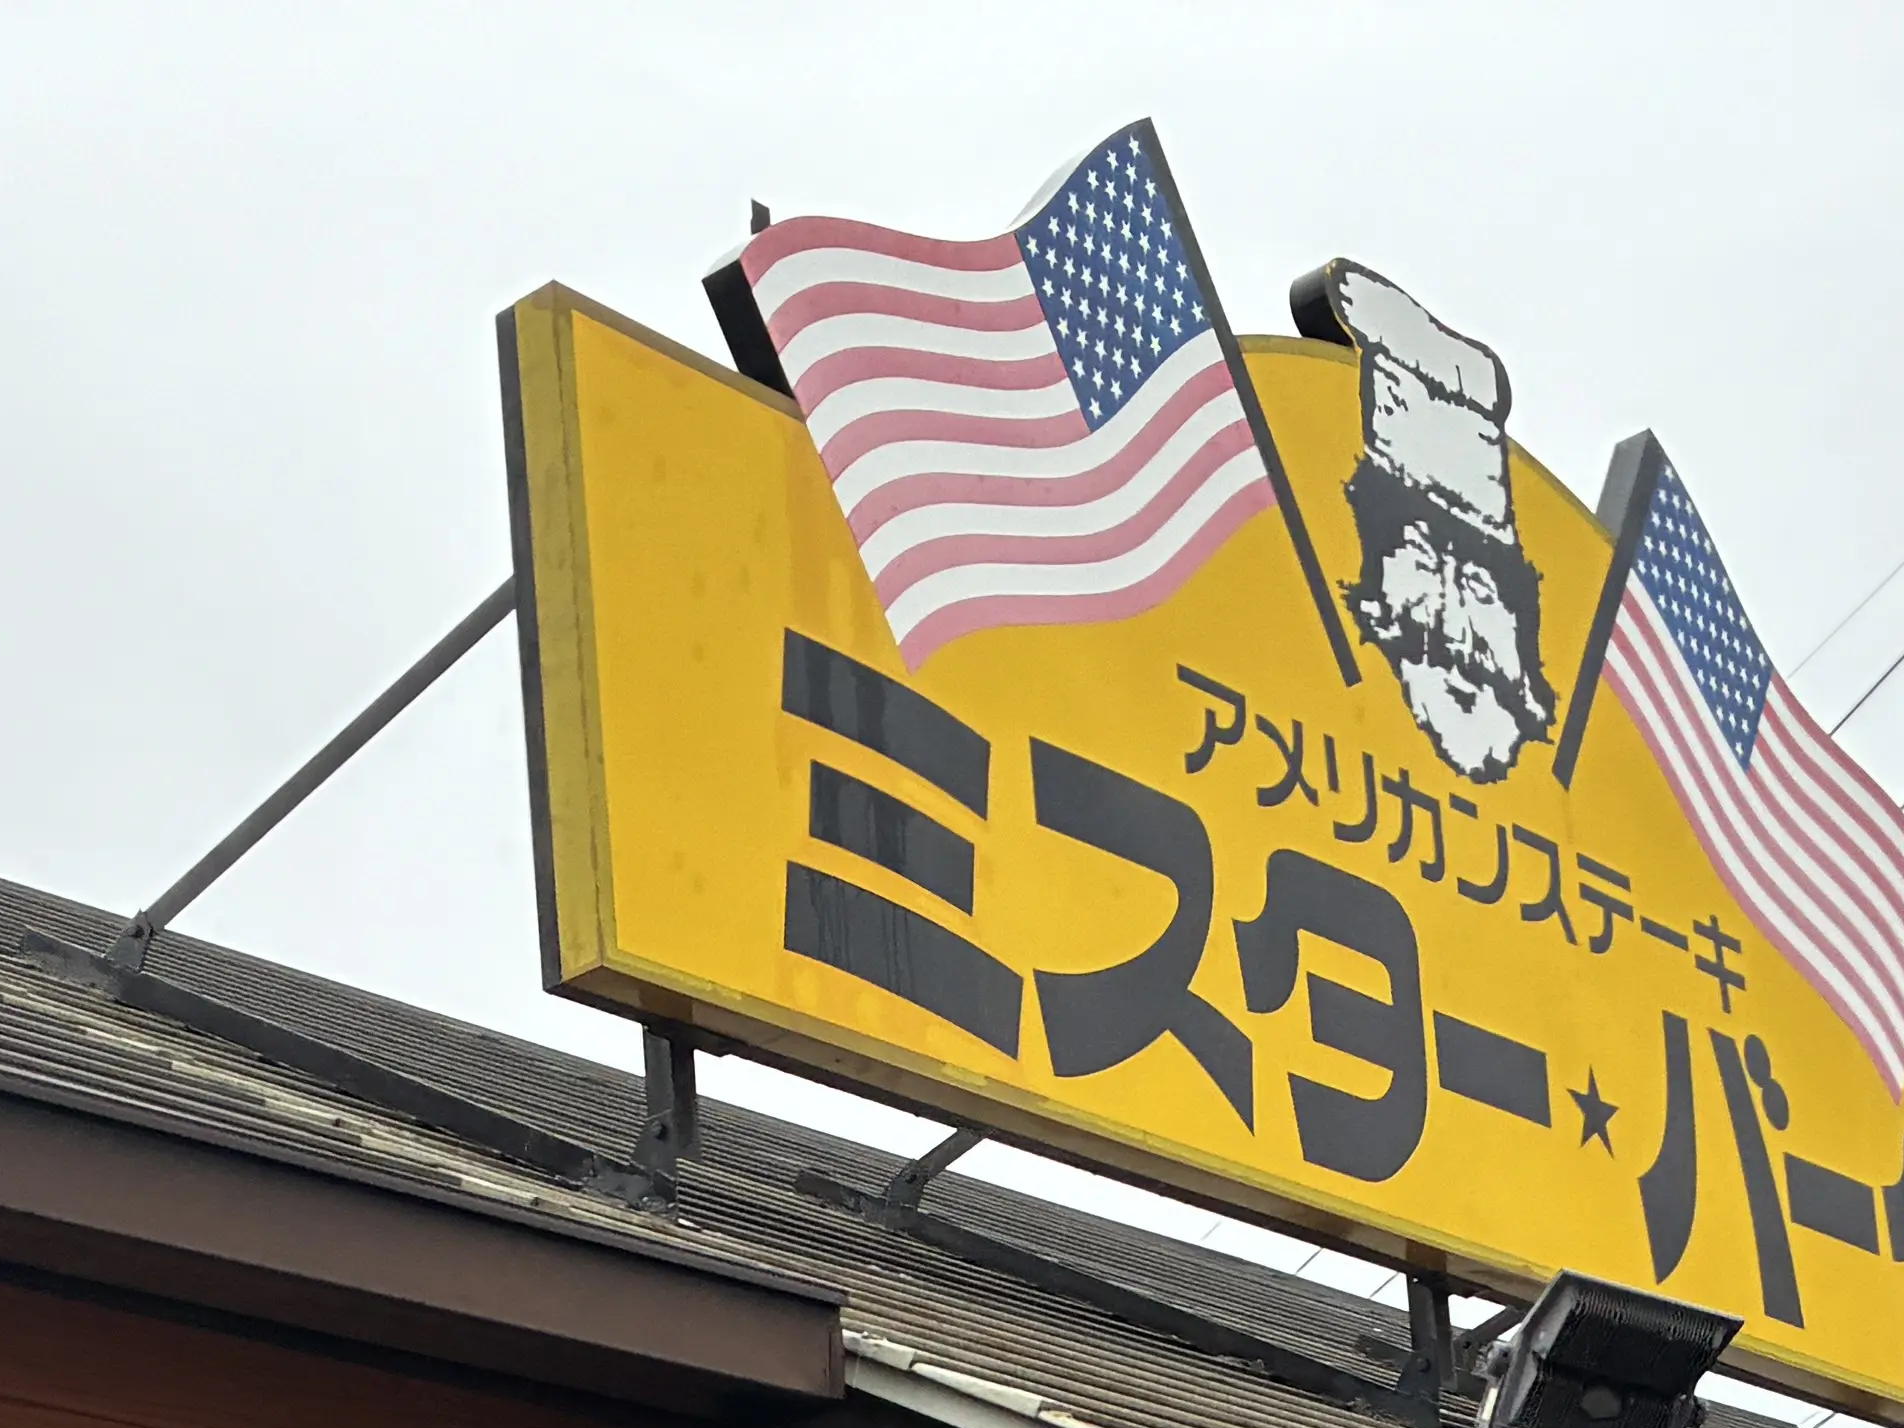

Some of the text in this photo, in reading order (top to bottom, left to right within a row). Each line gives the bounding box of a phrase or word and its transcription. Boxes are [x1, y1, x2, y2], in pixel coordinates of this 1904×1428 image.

[1176, 662, 1748, 1014] アメリカンステーキ
